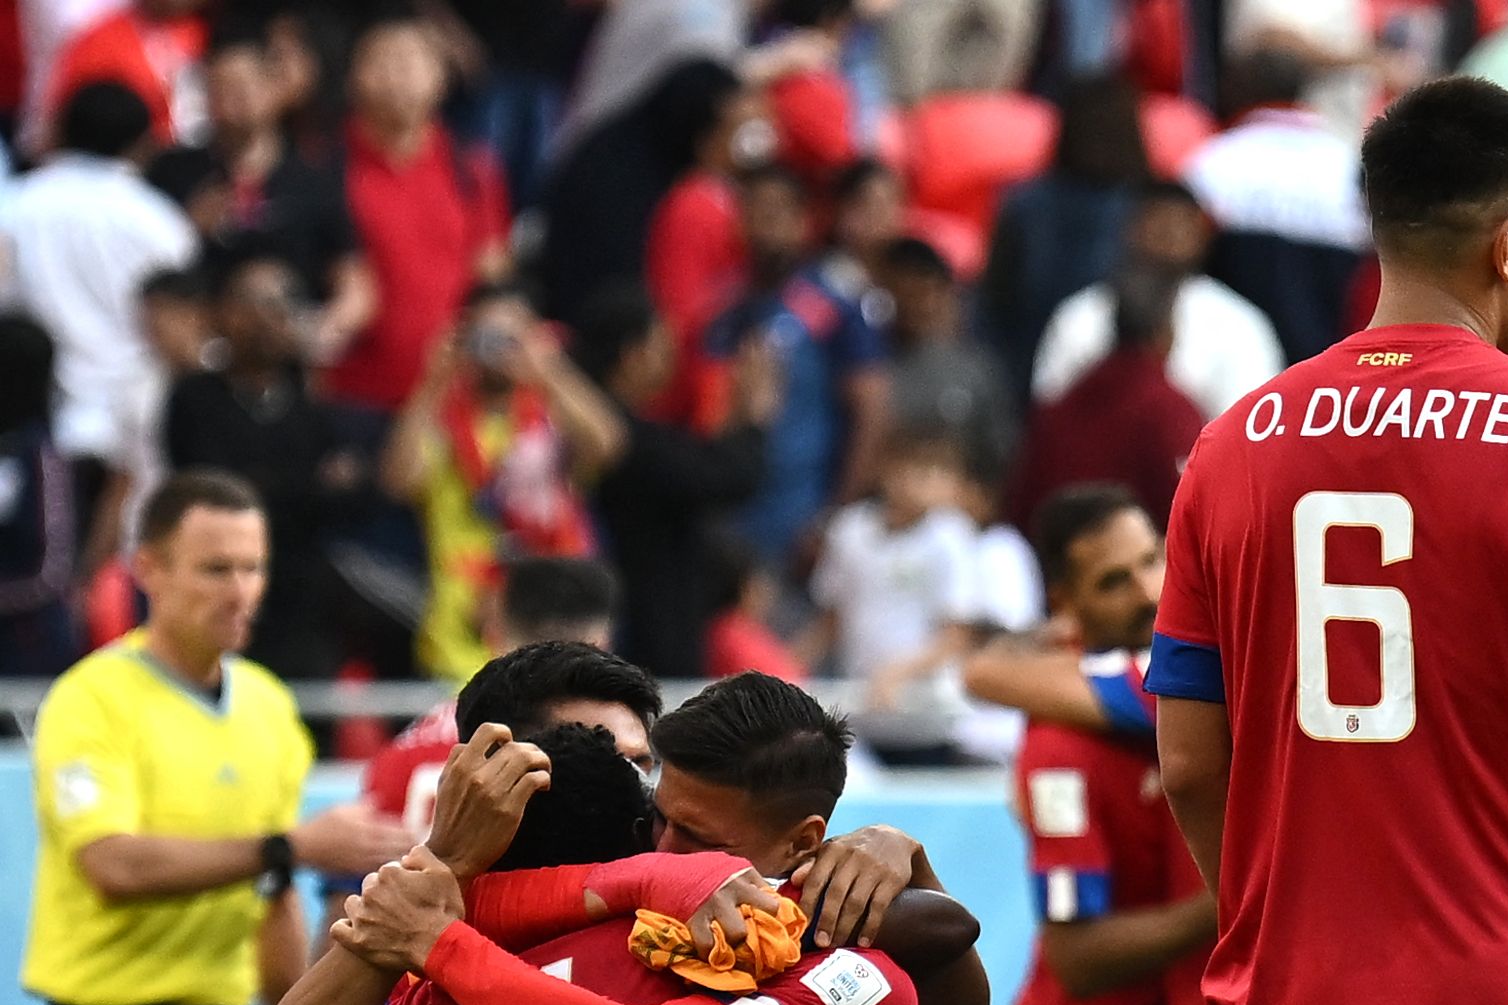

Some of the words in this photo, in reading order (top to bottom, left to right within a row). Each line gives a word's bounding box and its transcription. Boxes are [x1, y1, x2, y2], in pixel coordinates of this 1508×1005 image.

[1357, 352, 1412, 366] FCRF
[1245, 392, 1285, 442] O.
[1293, 490, 1417, 743] 6
